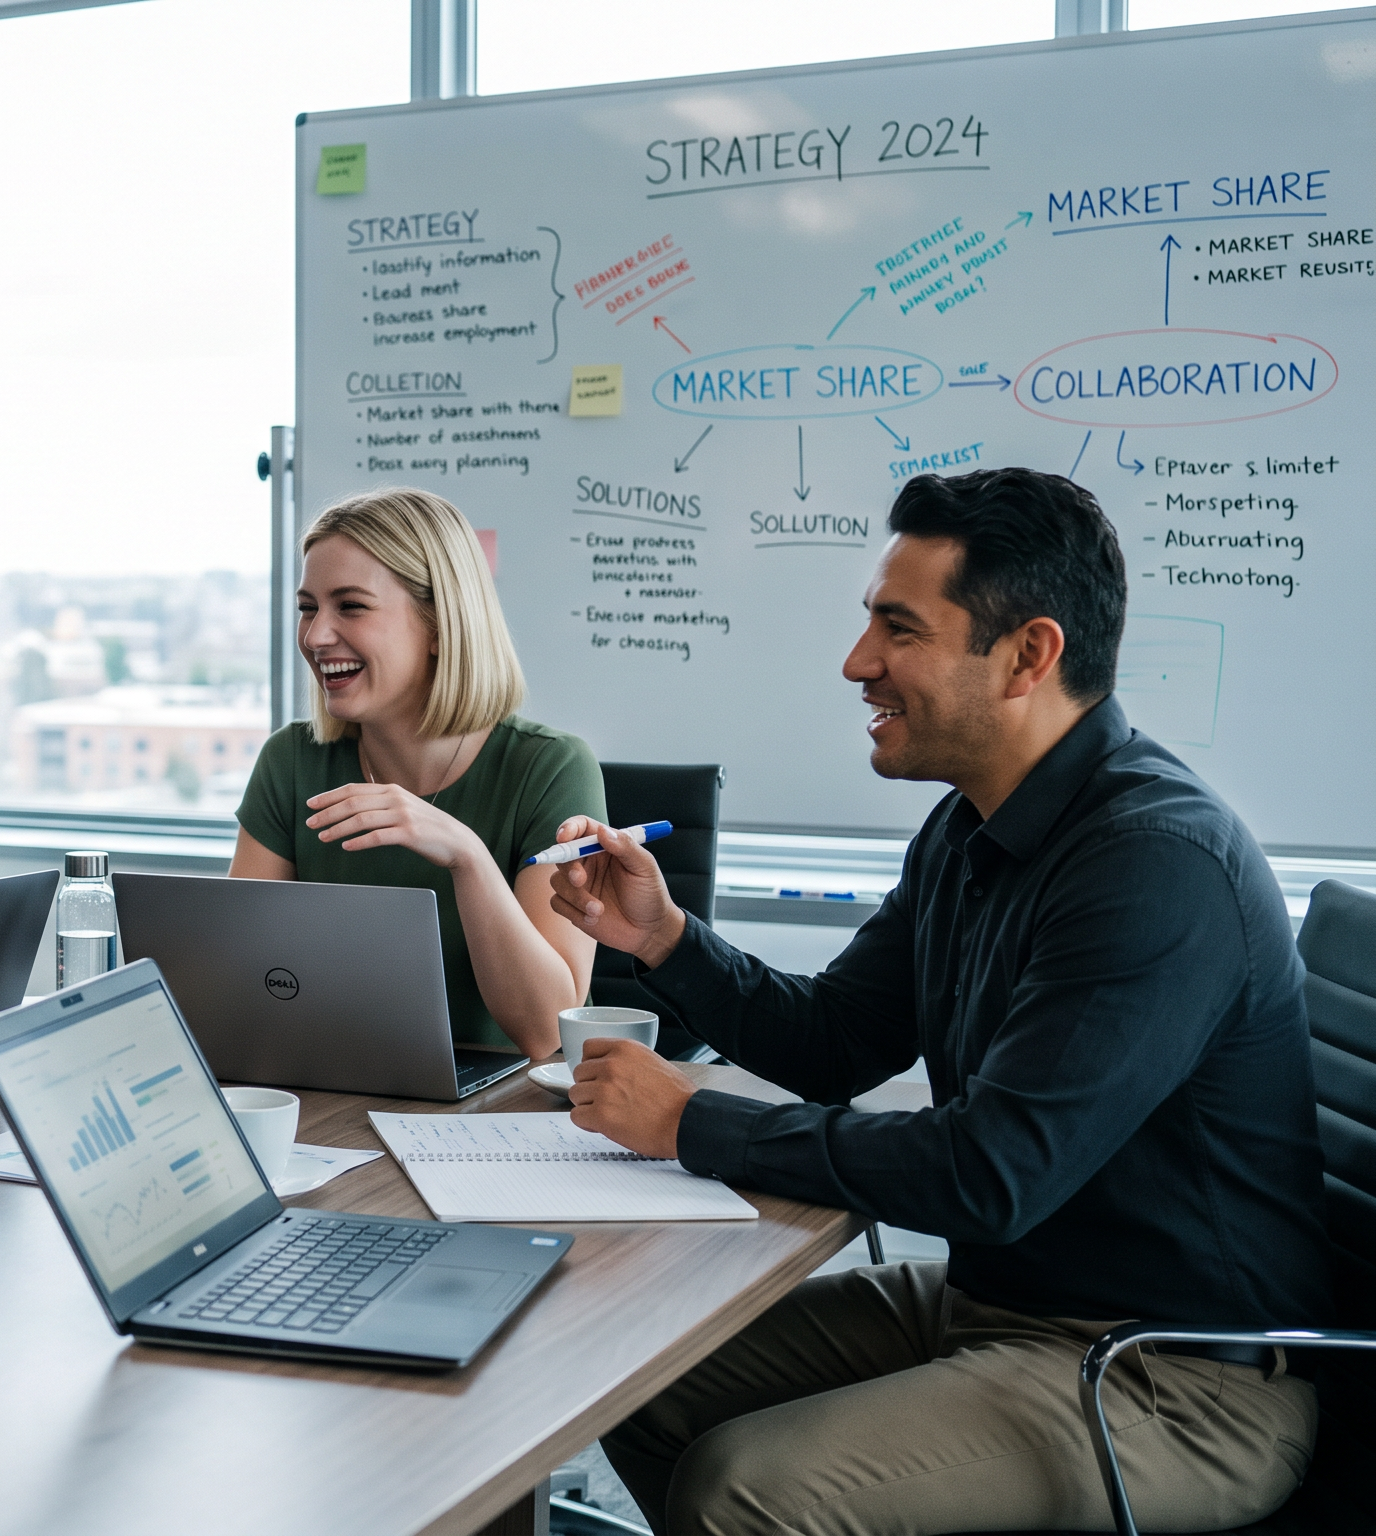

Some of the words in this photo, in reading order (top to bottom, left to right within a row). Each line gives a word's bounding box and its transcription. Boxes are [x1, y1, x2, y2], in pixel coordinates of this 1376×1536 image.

[646, 125, 852, 184] STRATEGY
[878, 115, 990, 163] 2024
[1049, 181, 1190, 222] MARKET
[1212, 170, 1330, 207] SHARE
[347, 208, 480, 247] STRATEGY
[1209, 233, 1294, 257] MARKET
[1307, 228, 1374, 248] SHARE
[440, 246, 541, 269] information
[1208, 264, 1288, 285] MARKET
[372, 283, 412, 301] Lead
[421, 279, 460, 297] ment
[442, 303, 487, 319] share
[444, 321, 538, 345] employment
[346, 371, 463, 396] COLLETION
[672, 367, 801, 404] MARKET
[816, 363, 922, 400] SHARE
[1031, 358, 1316, 403] COLLABORATION
[367, 404, 424, 423] Market
[431, 403, 474, 420] share
[428, 429, 444, 445] of
[456, 453, 530, 476] planning
[1266, 455, 1340, 474] limitet
[576, 475, 702, 519] SOLUTIONS
[750, 510, 869, 538] SOLLUTION
[619, 634, 690, 662] choosing
